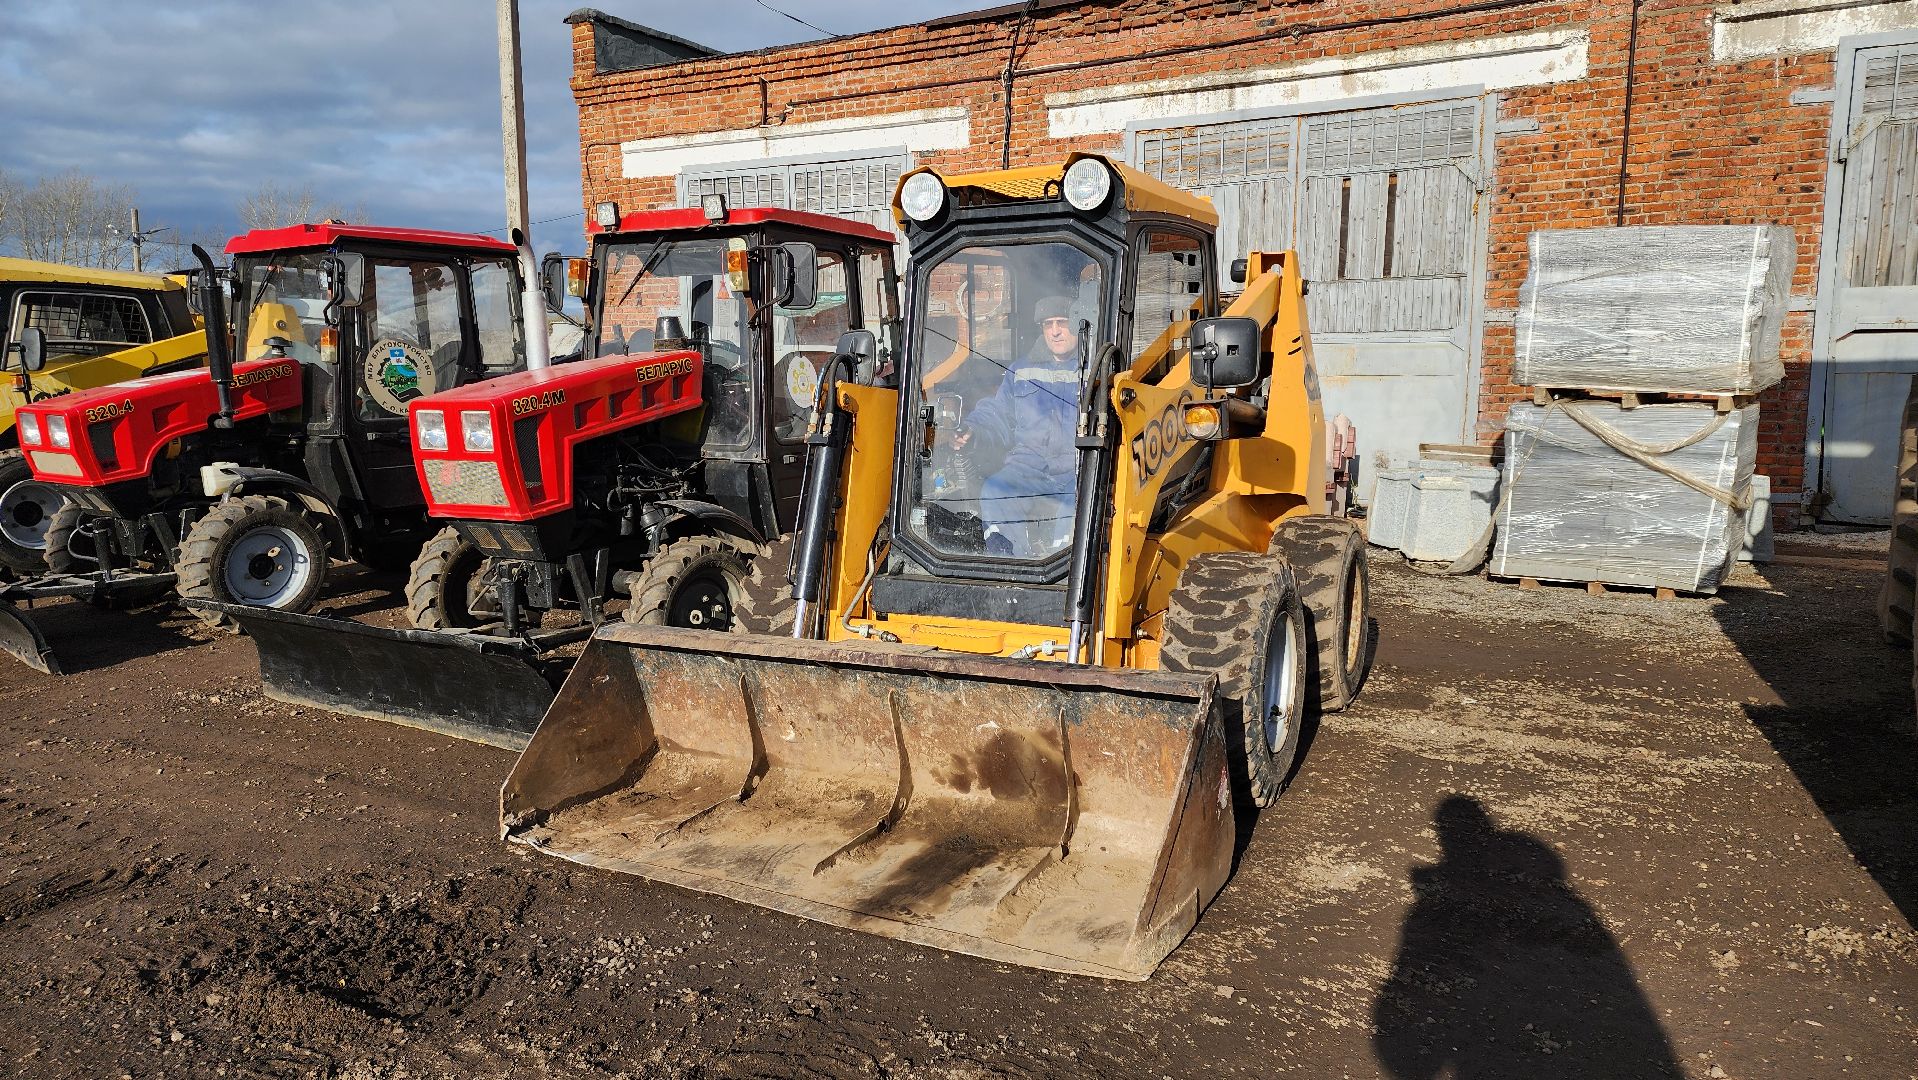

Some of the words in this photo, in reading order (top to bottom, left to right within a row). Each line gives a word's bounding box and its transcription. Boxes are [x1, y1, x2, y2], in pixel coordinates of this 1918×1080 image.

[636, 358, 692, 383] БЕЛАРУС
[86, 399, 134, 423] 320.4
[512, 389, 566, 415] 320.4М
